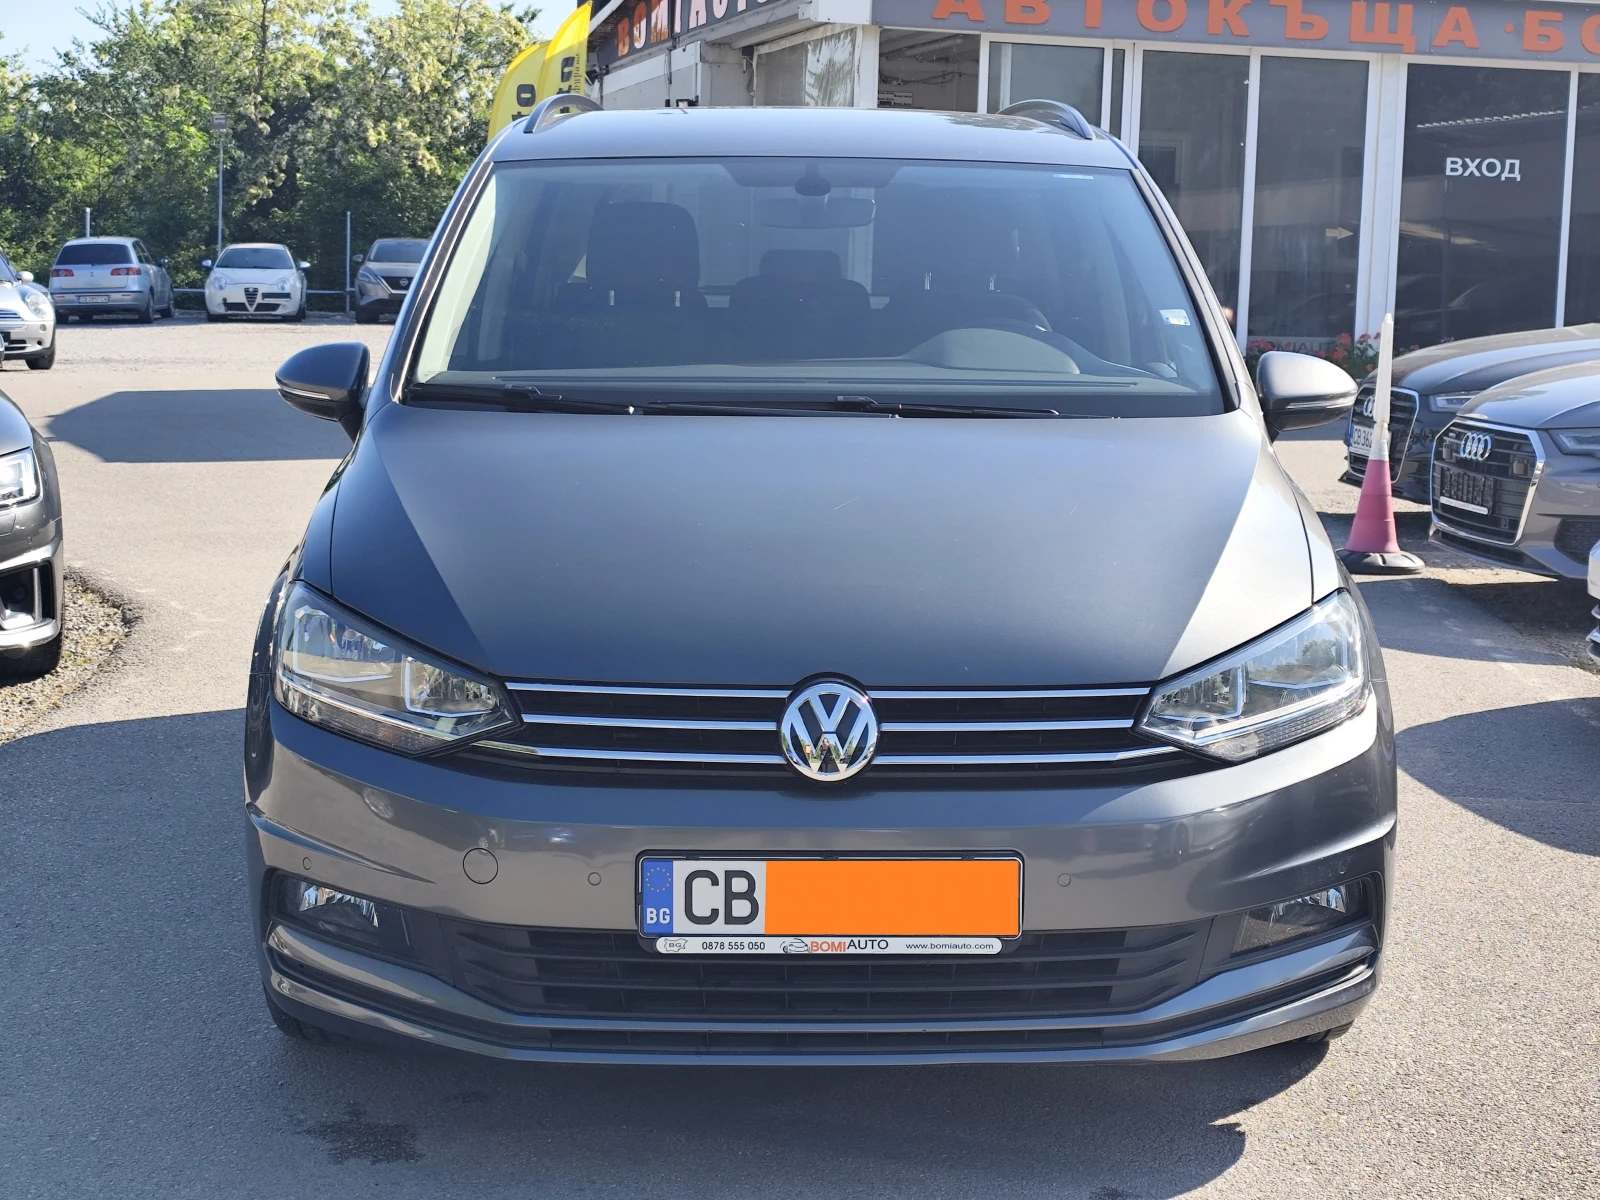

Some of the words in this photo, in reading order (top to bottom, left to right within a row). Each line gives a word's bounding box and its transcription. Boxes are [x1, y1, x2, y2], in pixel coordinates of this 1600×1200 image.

[617, 0, 767, 57] BOMI
[1445, 157, 1521, 181] ВХОД
[646, 907, 671, 924] BG
[684, 869, 760, 926] CB
[701, 941, 724, 951] 0878
[727, 941, 745, 951] 555
[747, 941, 766, 951] 050
[905, 942, 994, 951] www.bomiauto.com
